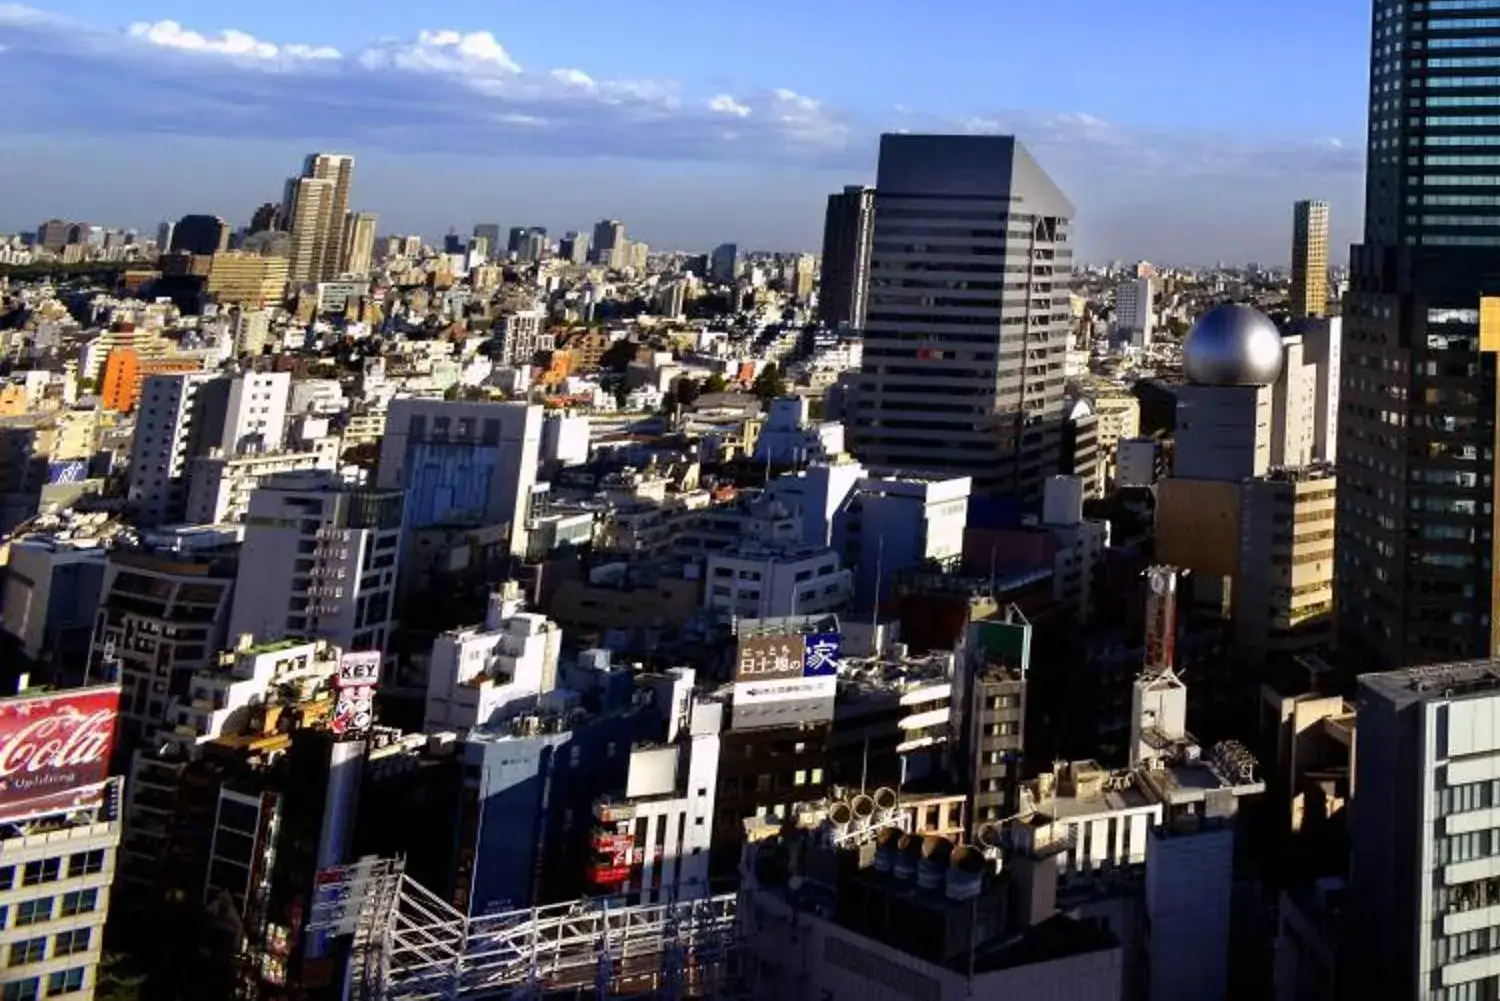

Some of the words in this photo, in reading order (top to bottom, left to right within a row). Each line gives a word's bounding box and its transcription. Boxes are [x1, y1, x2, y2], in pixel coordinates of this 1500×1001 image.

[806, 640, 839, 670] 家
[341, 664, 376, 678] KEY
[0, 707, 118, 777] Cola
